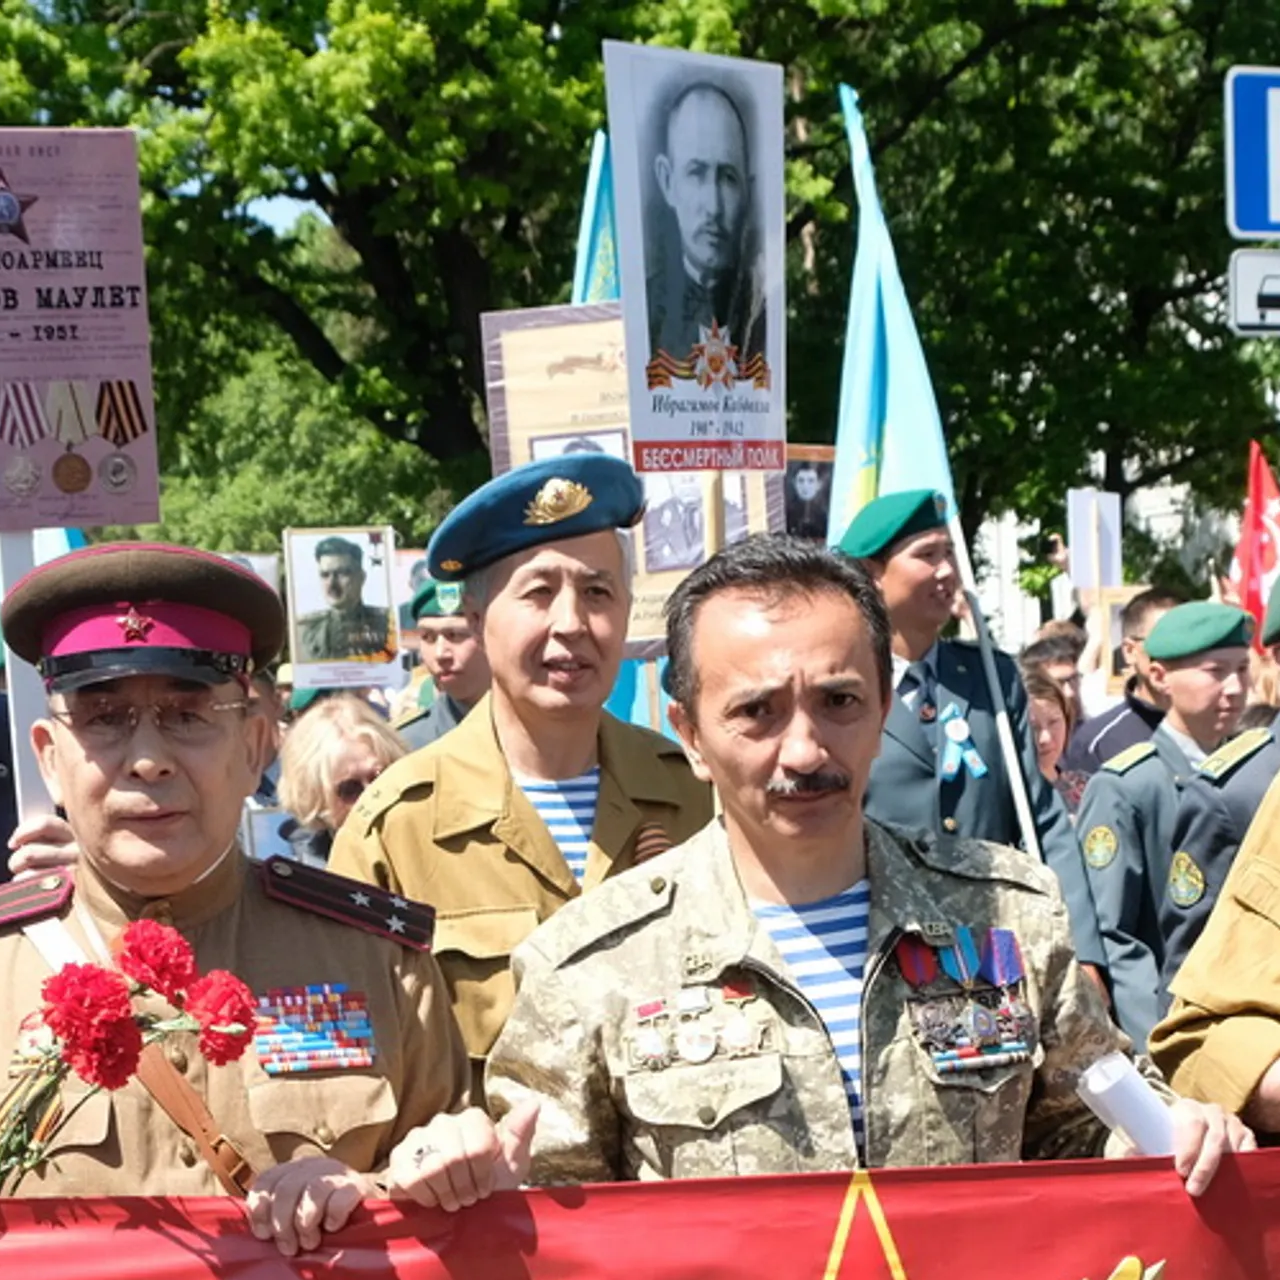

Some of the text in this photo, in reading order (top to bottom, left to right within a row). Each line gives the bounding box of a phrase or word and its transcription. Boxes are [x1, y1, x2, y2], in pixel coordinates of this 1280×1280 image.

[35, 285, 142, 309] МАУЛЕТ
[33, 324, 81, 342] 1951
[641, 444, 780, 470] БЕССМЕРТНЫЙ ПОЛК
